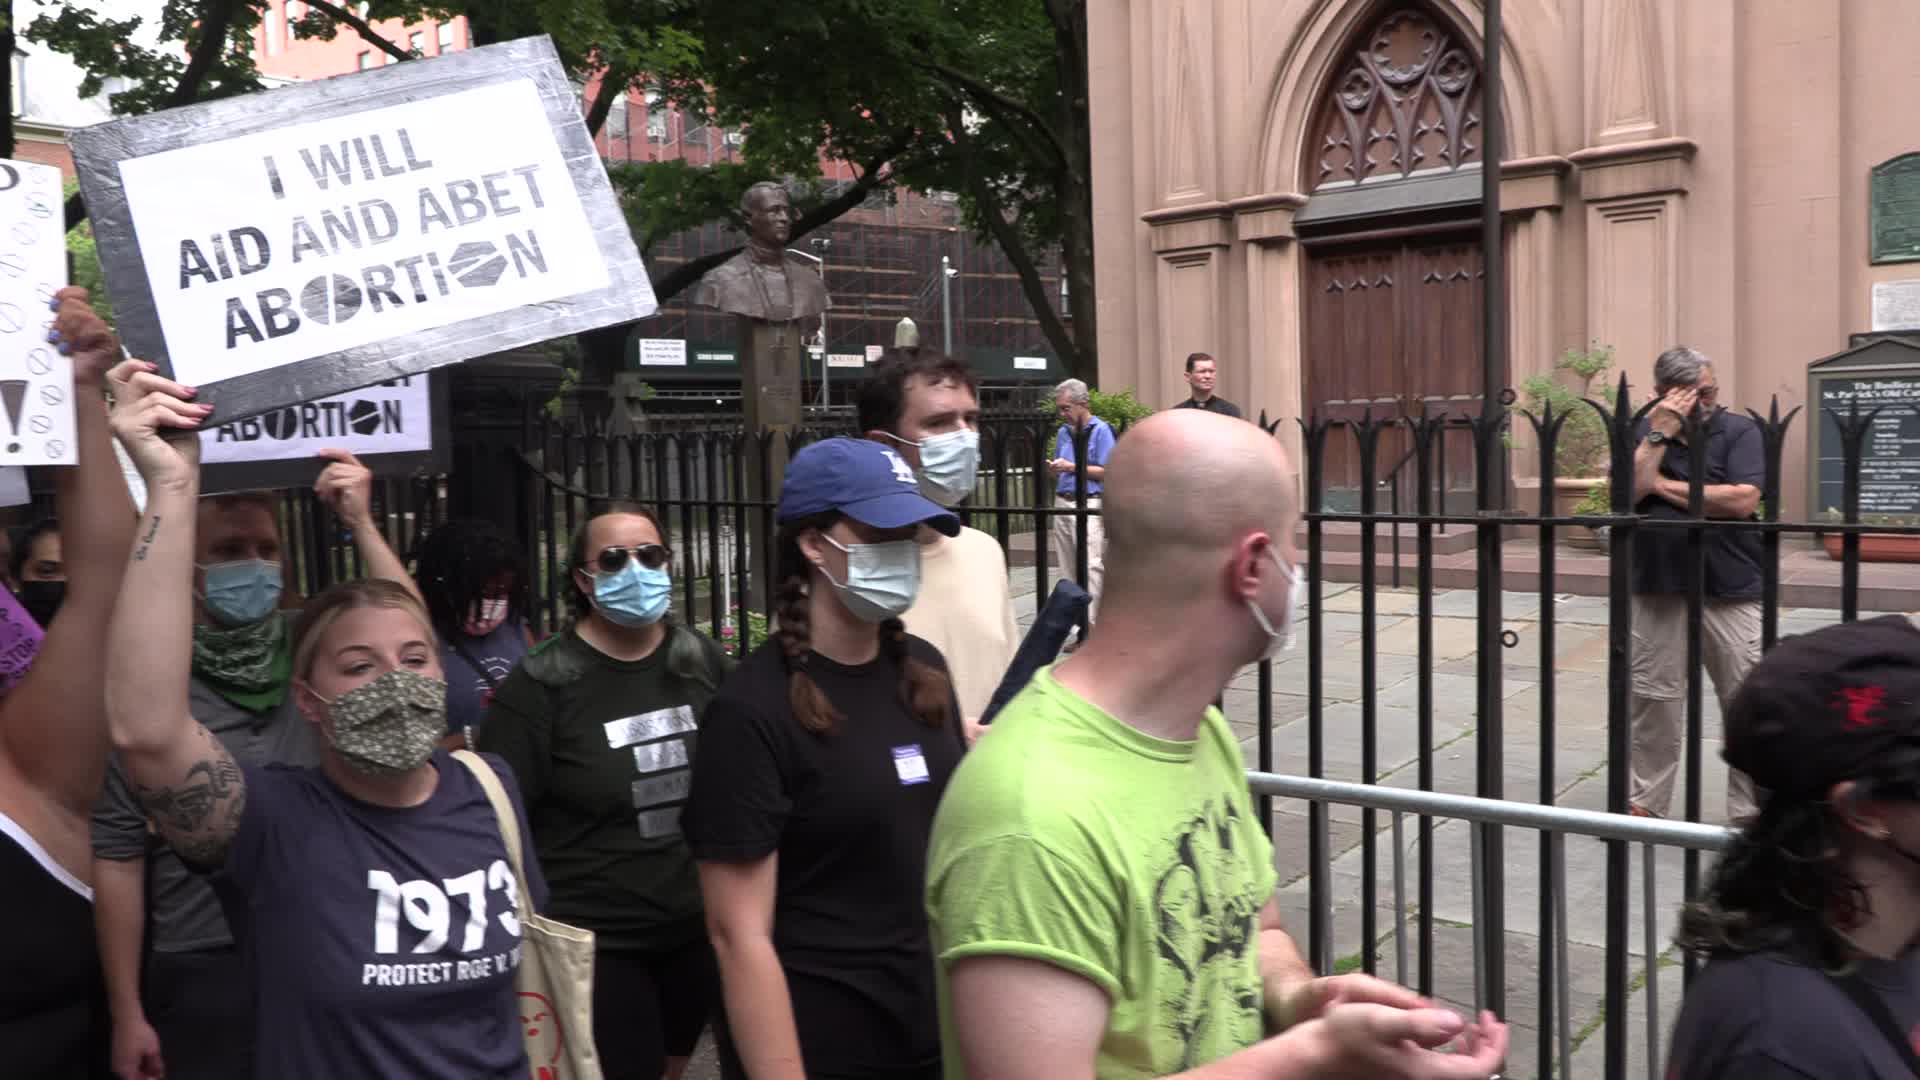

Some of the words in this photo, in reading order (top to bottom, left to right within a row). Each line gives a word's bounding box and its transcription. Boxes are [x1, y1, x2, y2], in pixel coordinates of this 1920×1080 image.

[263, 155, 286, 200] I
[299, 128, 433, 190] WILL
[291, 199, 399, 263] AND
[418, 164, 545, 234] ABET
[216, 399, 404, 442] ABORTION
[367, 858, 521, 955] 1973
[361, 962, 453, 986] PROTECT
[457, 957, 493, 981] ROE
